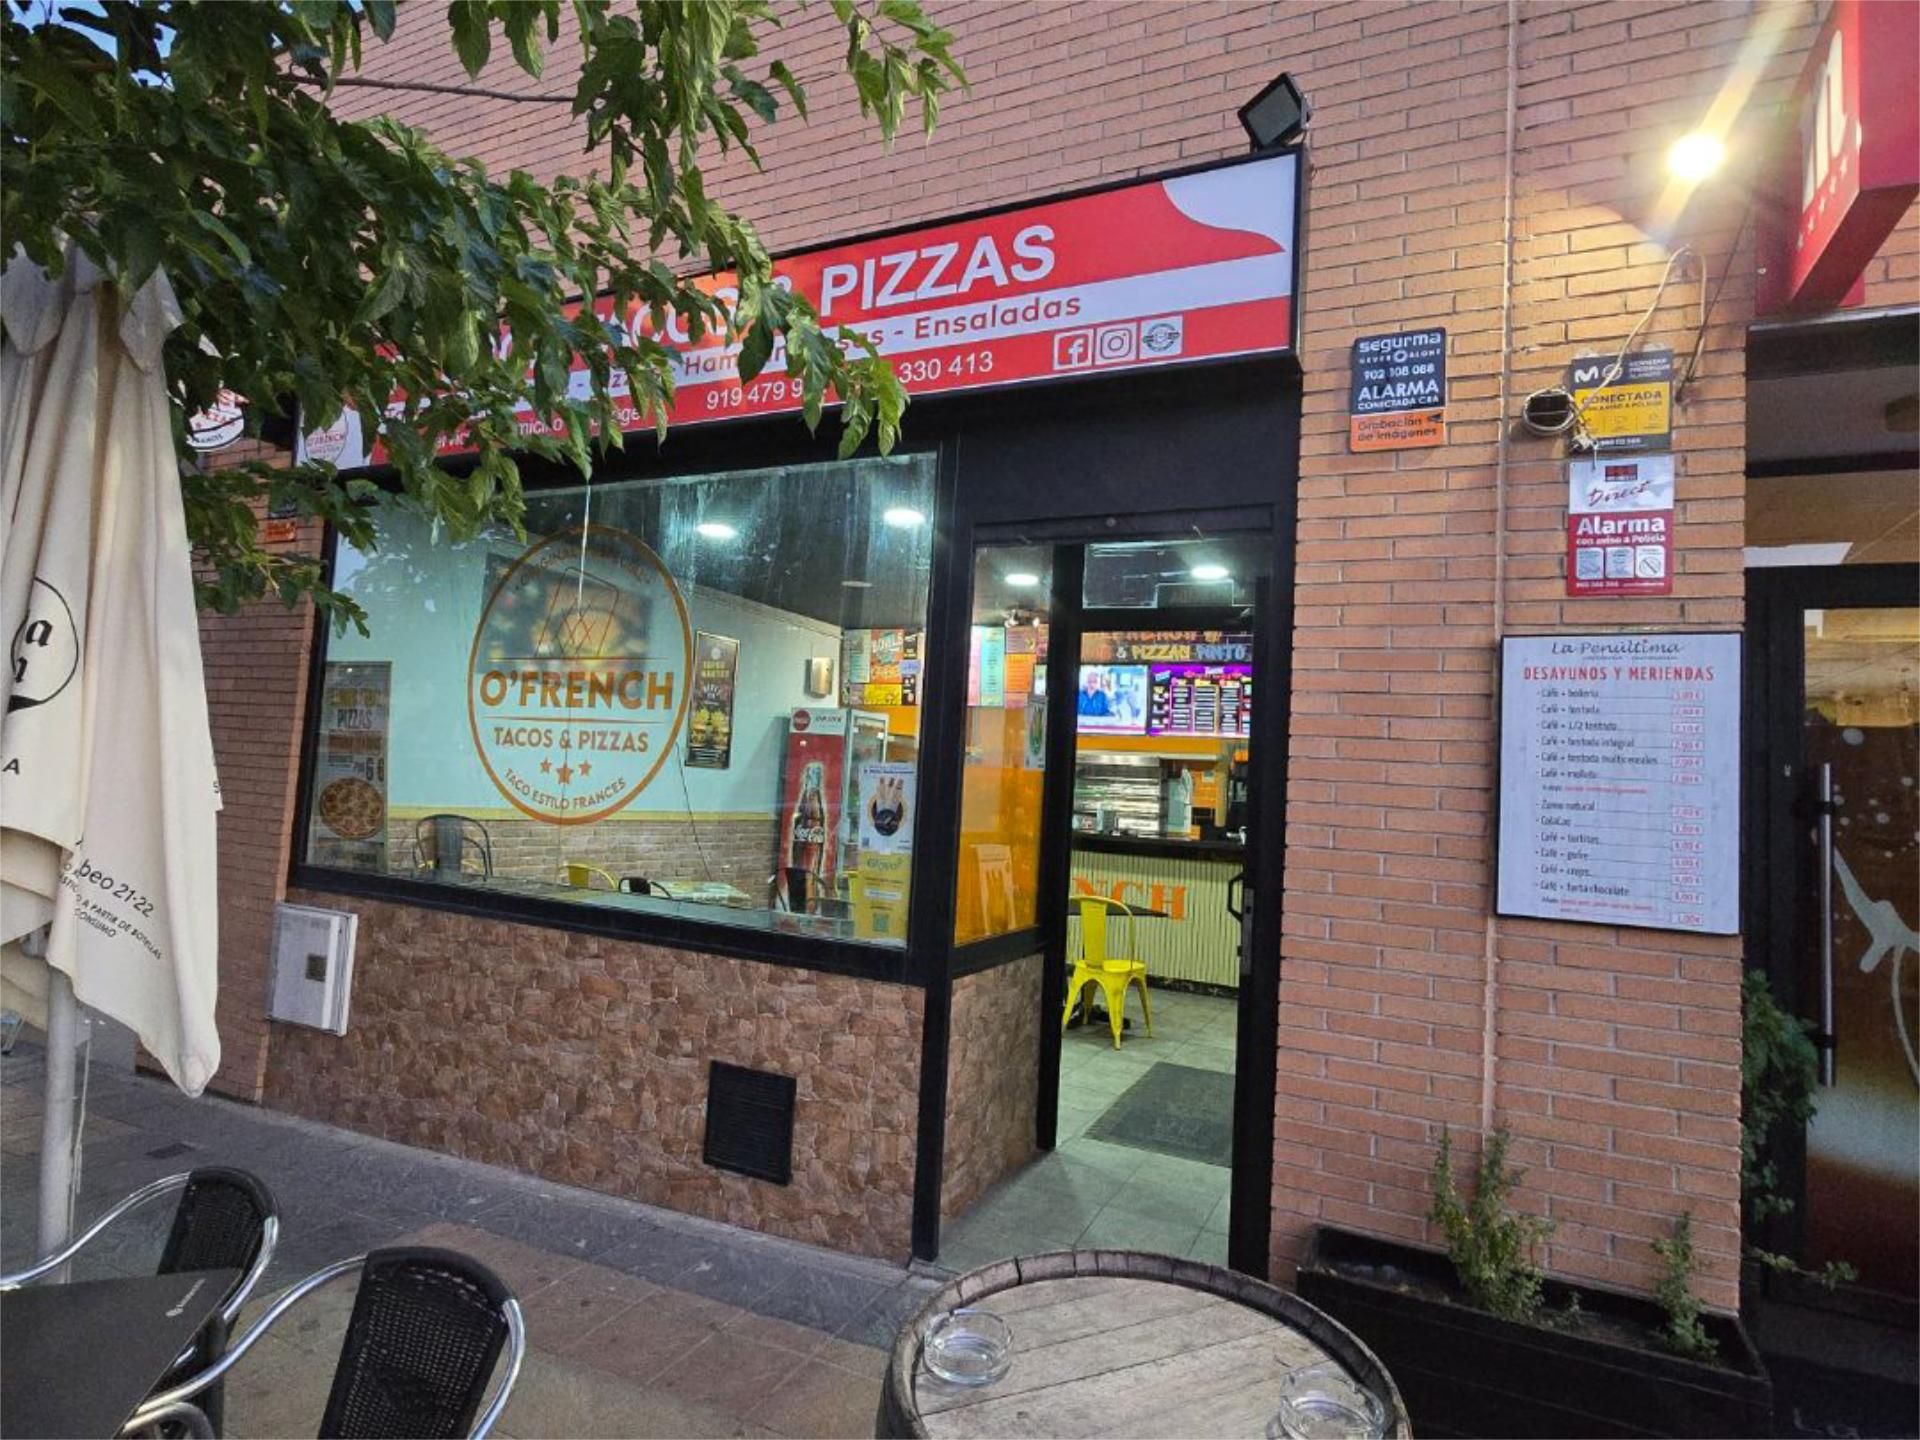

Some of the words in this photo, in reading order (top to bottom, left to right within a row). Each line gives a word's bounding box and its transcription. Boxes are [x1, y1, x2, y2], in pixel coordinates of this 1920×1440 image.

[820, 225, 1056, 317] PIZZAS
[915, 297, 1081, 340] Ensaladas
[1359, 332, 1441, 353] segurma
[899, 358, 942, 383] 330
[948, 351, 994, 376] 413
[706, 387, 743, 410] 919
[747, 379, 786, 404] 479
[1358, 379, 1439, 401] ALARMA
[1358, 397, 1416, 410] CONECTADA
[1576, 516, 1665, 535] Alarma
[1551, 641, 1576, 655] La
[1524, 666, 1607, 681] DESAYUNOS
[1614, 666, 1622, 681] Y
[1628, 666, 1715, 681] MERIENDAS
[480, 669, 674, 710] O'FRENCH
[493, 726, 553, 748] TACOS
[559, 729, 572, 750] &
[578, 730, 649, 753] PIZZAS
[504, 768, 531, 796] TACO
[532, 789, 570, 810] ESTILO
[573, 777, 626, 809] FRANCES
